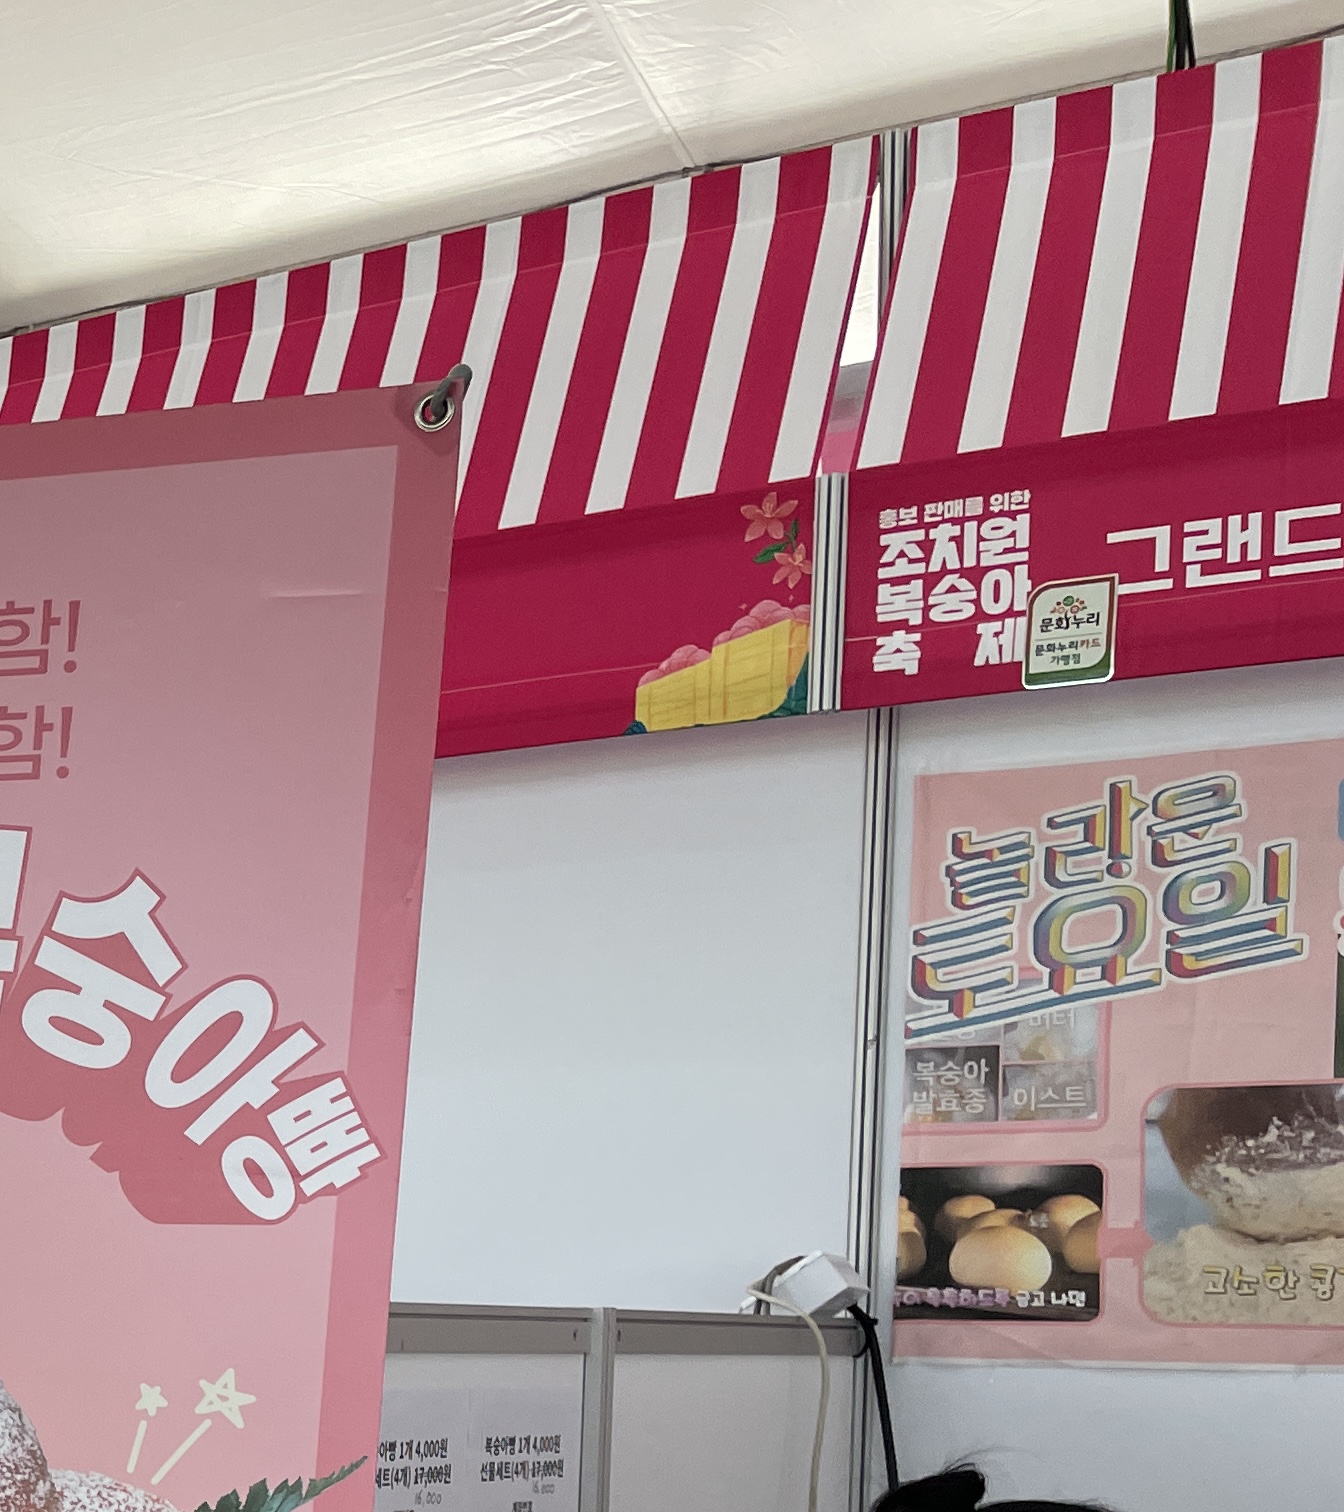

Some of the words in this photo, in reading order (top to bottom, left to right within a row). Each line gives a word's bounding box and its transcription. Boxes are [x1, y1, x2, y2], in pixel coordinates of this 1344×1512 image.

[879, 506, 918, 529] 홍보
[989, 489, 1031, 513] 위한
[877, 513, 1031, 580] 조치원
[1106, 503, 1344, 595] 그랜드
[876, 564, 1032, 626] 복숭아
[1039, 612, 1100, 634] 문화누리
[946, 774, 1243, 911] 놀라운
[905, 843, 1306, 1041] 토요일
[914, 1058, 990, 1086] 복숭아
[912, 1088, 987, 1115] 발효종
[1014, 1085, 1087, 1111] 이스트
[1203, 1264, 1300, 1300] 고소한
[1310, 1263, 1344, 1300] 콩
[378, 1440, 396, 1461] 아빵
[400, 1439, 413, 1460] 1개
[416, 1438, 448, 1462] 4,000원
[485, 1436, 516, 1456] 복숭아빵
[518, 1436, 531, 1455] 1개
[532, 1435, 561, 1456] 4,000원
